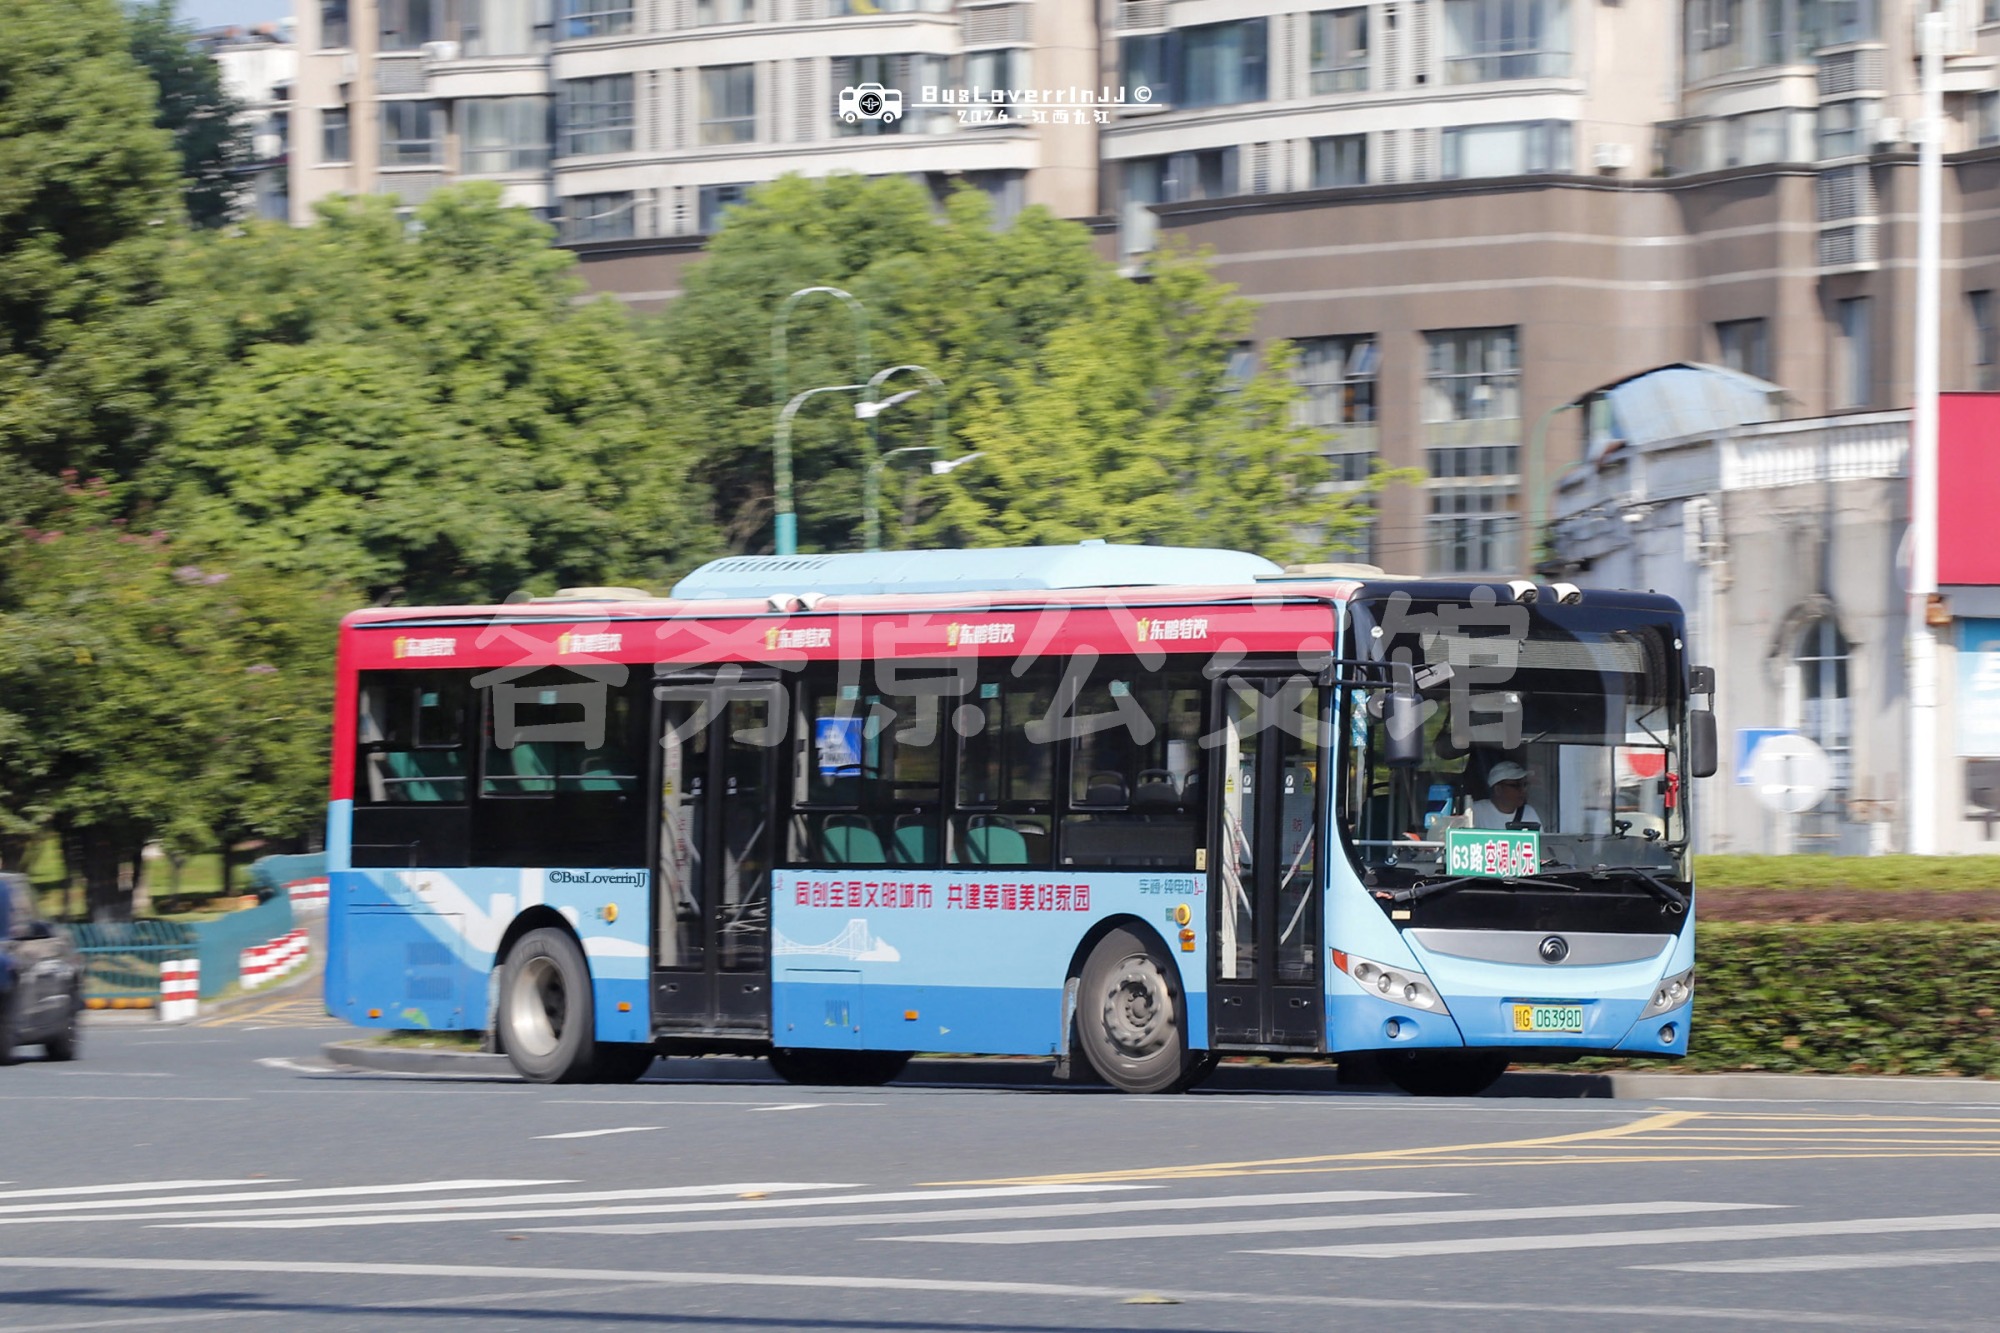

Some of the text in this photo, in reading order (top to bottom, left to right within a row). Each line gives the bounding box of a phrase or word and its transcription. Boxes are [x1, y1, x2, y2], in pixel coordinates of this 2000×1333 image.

[959, 623, 1015, 645] 东鹏特饮
[1150, 618, 1208, 640] 东鹏特饮
[795, 880, 933, 909] 同创全国文明城市
[946, 882, 1091, 912] 共建幸福美好家园
